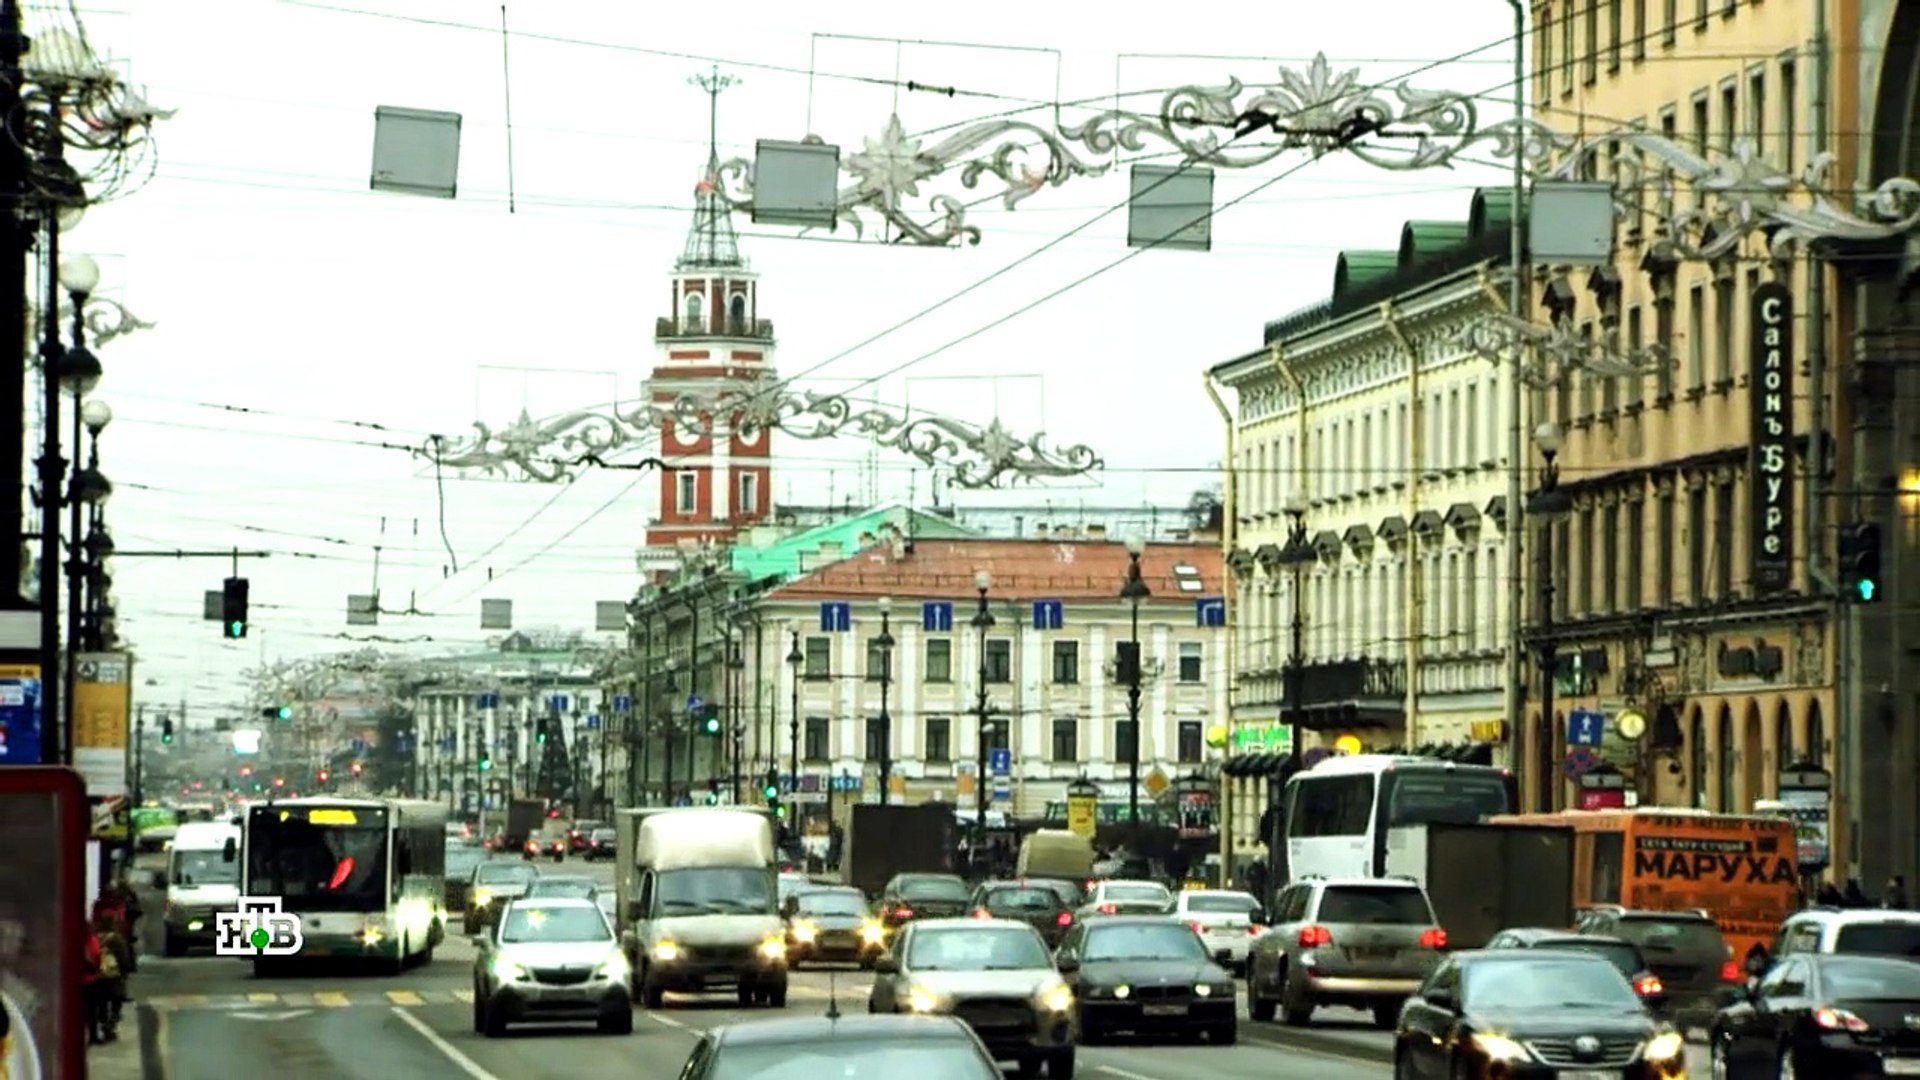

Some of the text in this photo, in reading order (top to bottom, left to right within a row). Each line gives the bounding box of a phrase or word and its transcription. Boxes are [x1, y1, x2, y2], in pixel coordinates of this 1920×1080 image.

[1761, 298, 1783, 436] Салонъ
[1761, 444, 1784, 554] Буре
[1634, 851, 1796, 886] МАРУХА
